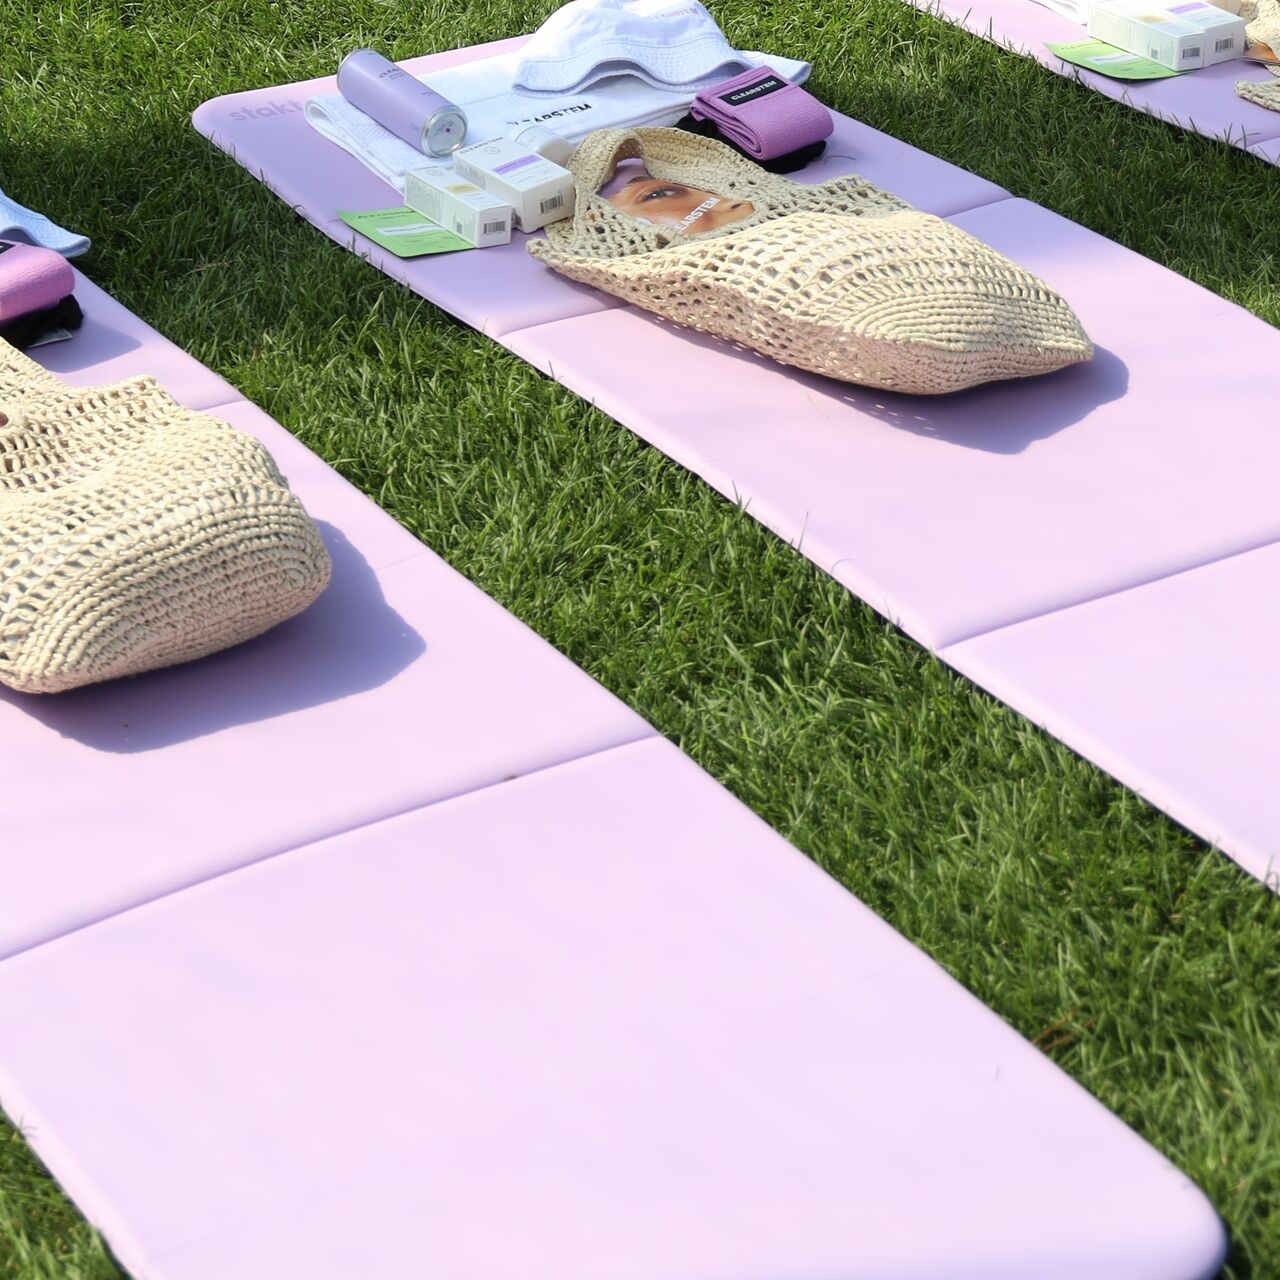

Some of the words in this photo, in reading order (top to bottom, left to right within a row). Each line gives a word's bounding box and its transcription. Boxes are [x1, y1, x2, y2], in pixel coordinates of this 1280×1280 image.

[731, 81, 777, 101] CLEARSTEM
[229, 100, 303, 121] stakt
[505, 103, 593, 126] ARSTEM
[675, 196, 721, 231] EARSTEM
